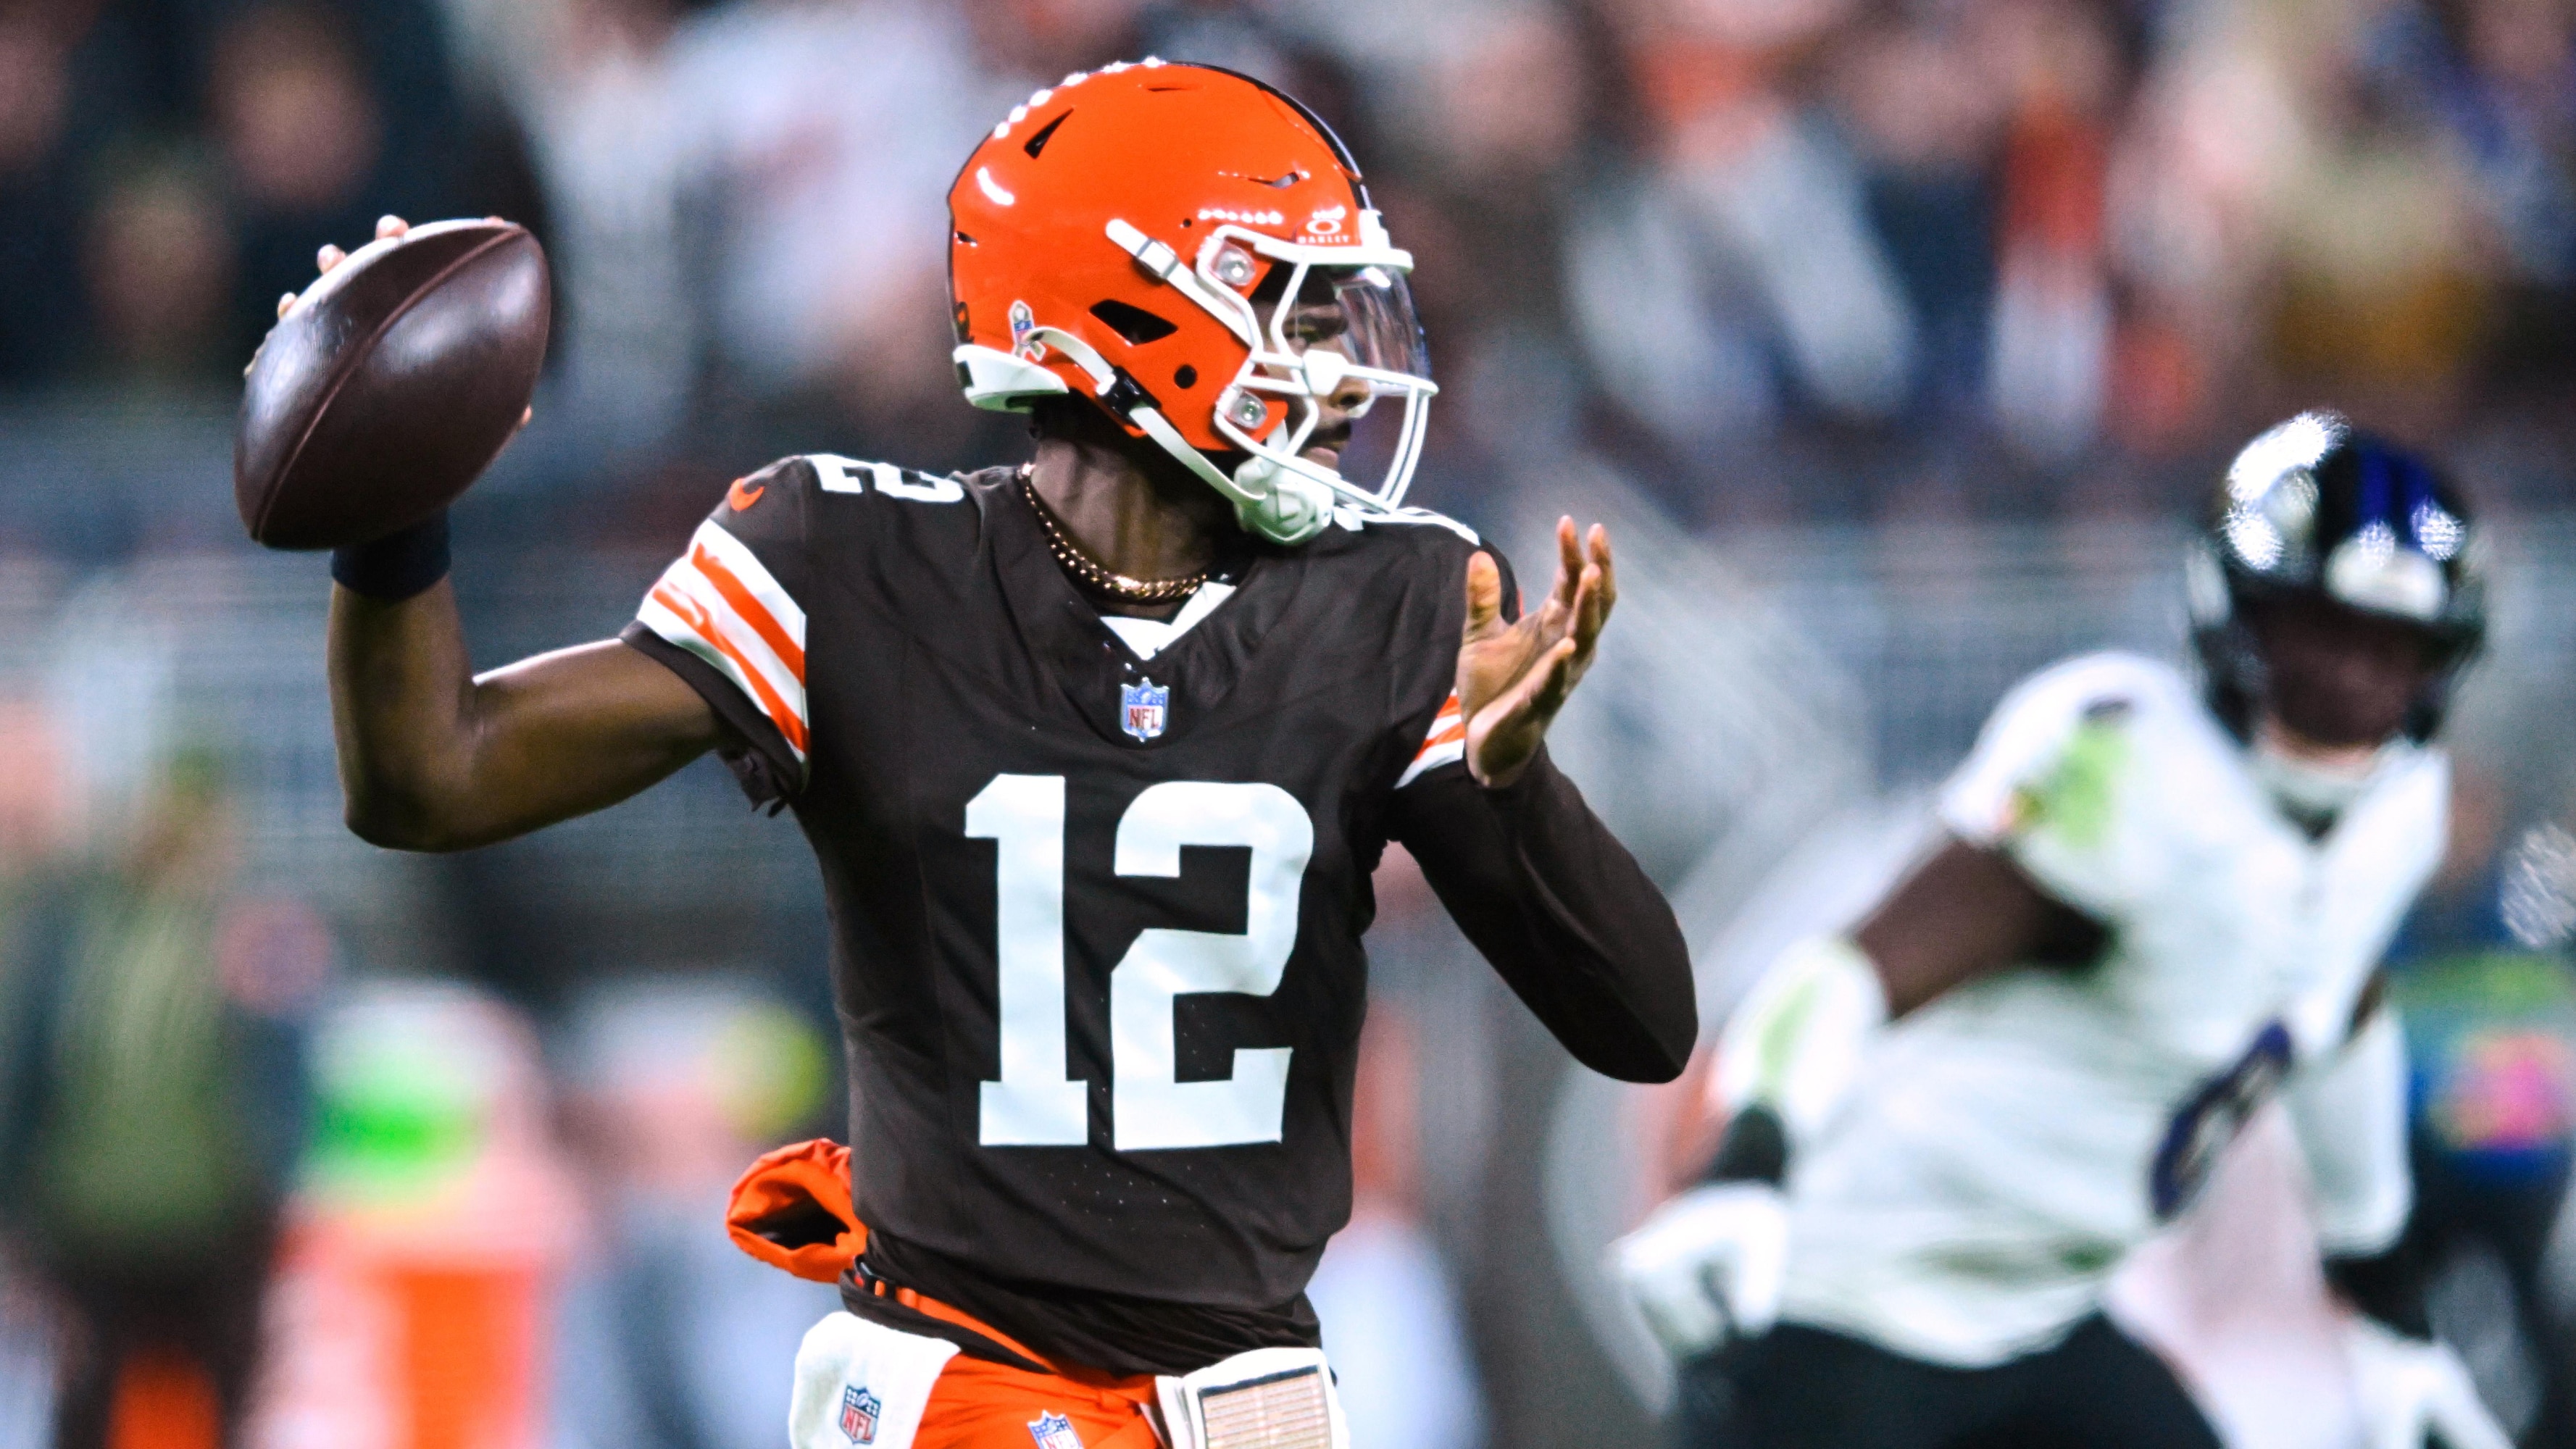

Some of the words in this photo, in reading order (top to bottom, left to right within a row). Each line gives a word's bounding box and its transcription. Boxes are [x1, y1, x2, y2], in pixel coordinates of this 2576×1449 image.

[1298, 235, 1349, 243] OAKLEY
[1129, 708, 1160, 730] NFL
[965, 773, 1314, 1151] 12
[843, 1405, 872, 1440] NFL
